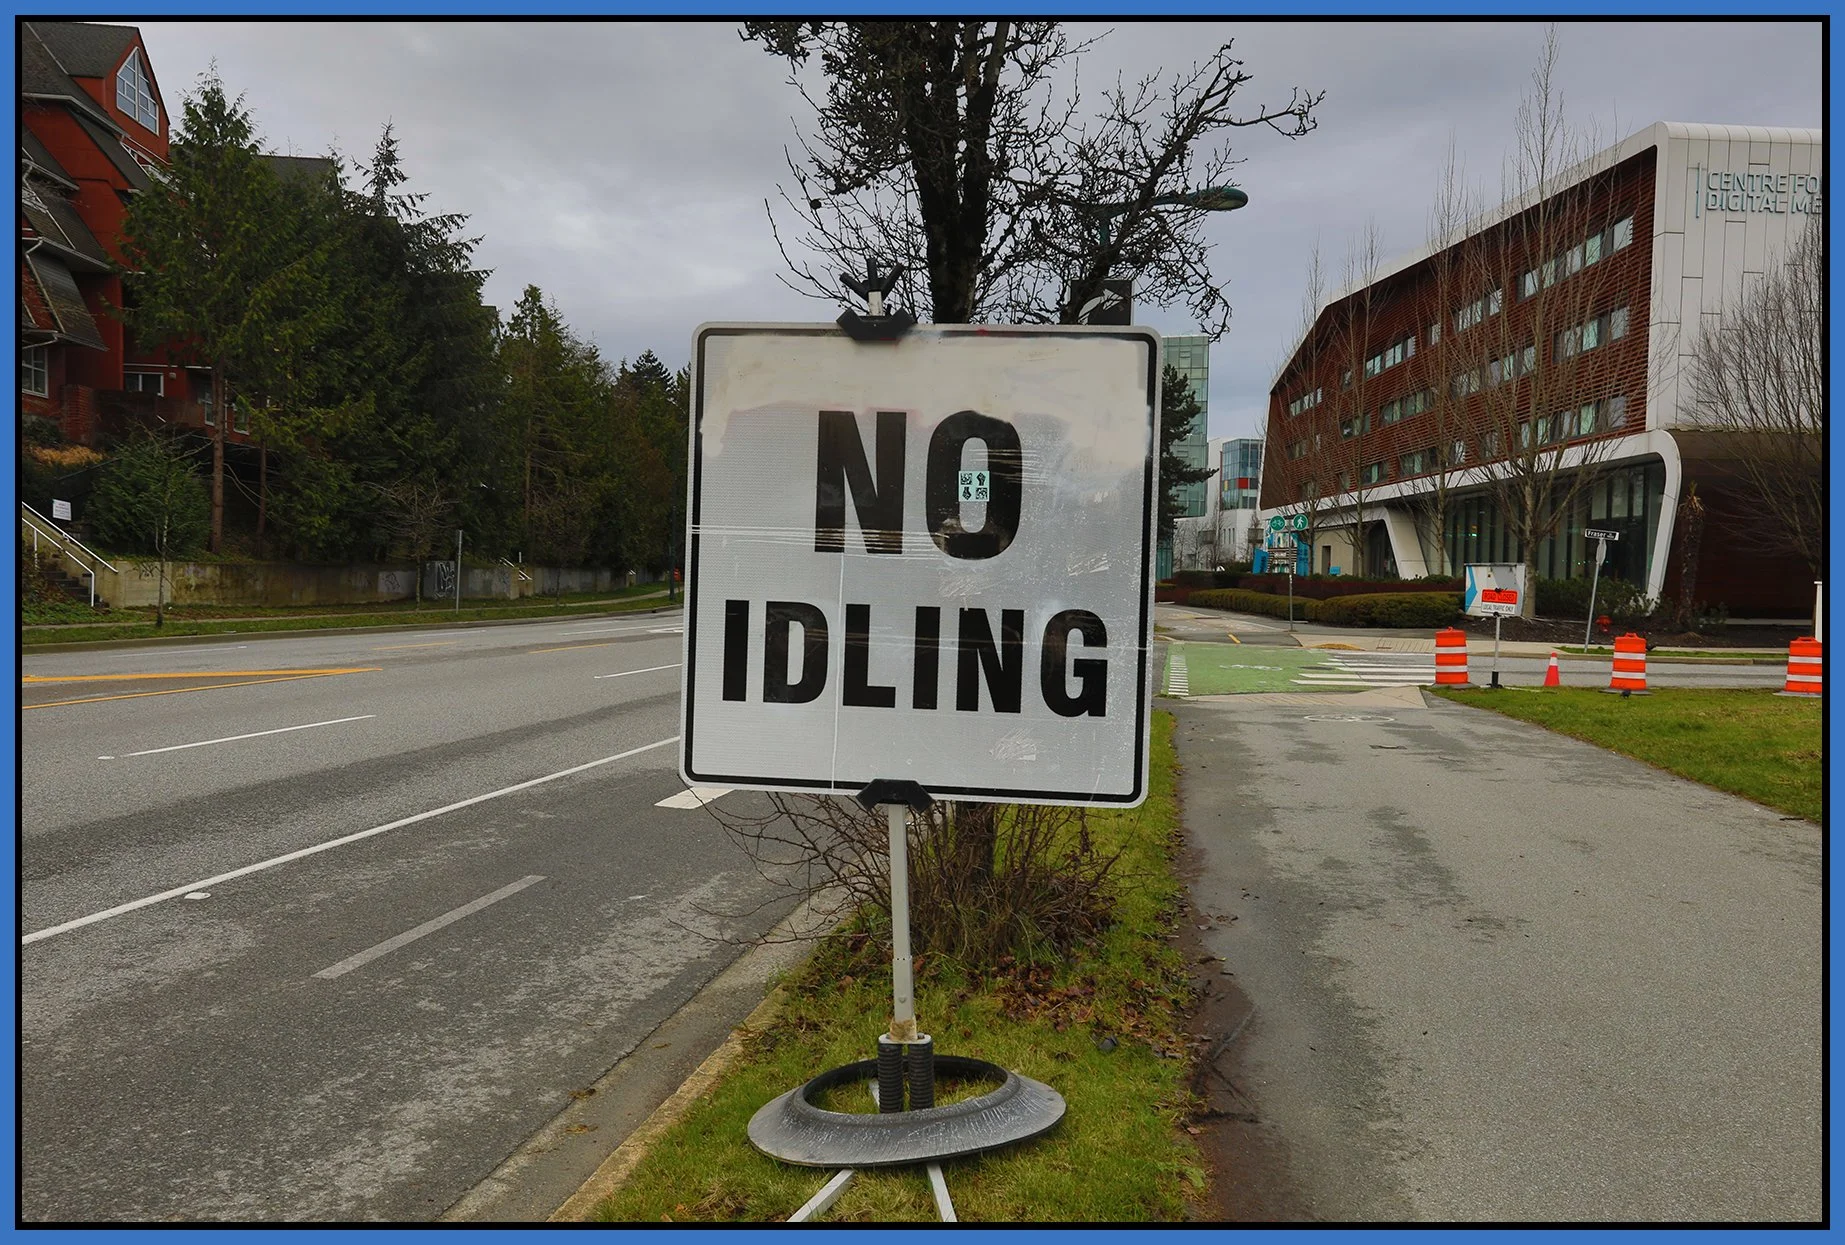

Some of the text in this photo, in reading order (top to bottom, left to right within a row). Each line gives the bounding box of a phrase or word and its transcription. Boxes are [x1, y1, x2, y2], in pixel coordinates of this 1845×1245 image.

[1707, 171, 1822, 195] CENTRE FO
[1706, 191, 1786, 214] DIGITAL
[814, 409, 1023, 560] NO
[1484, 592, 1514, 602] ROAD CLOSED
[722, 599, 1109, 718] IDLING
